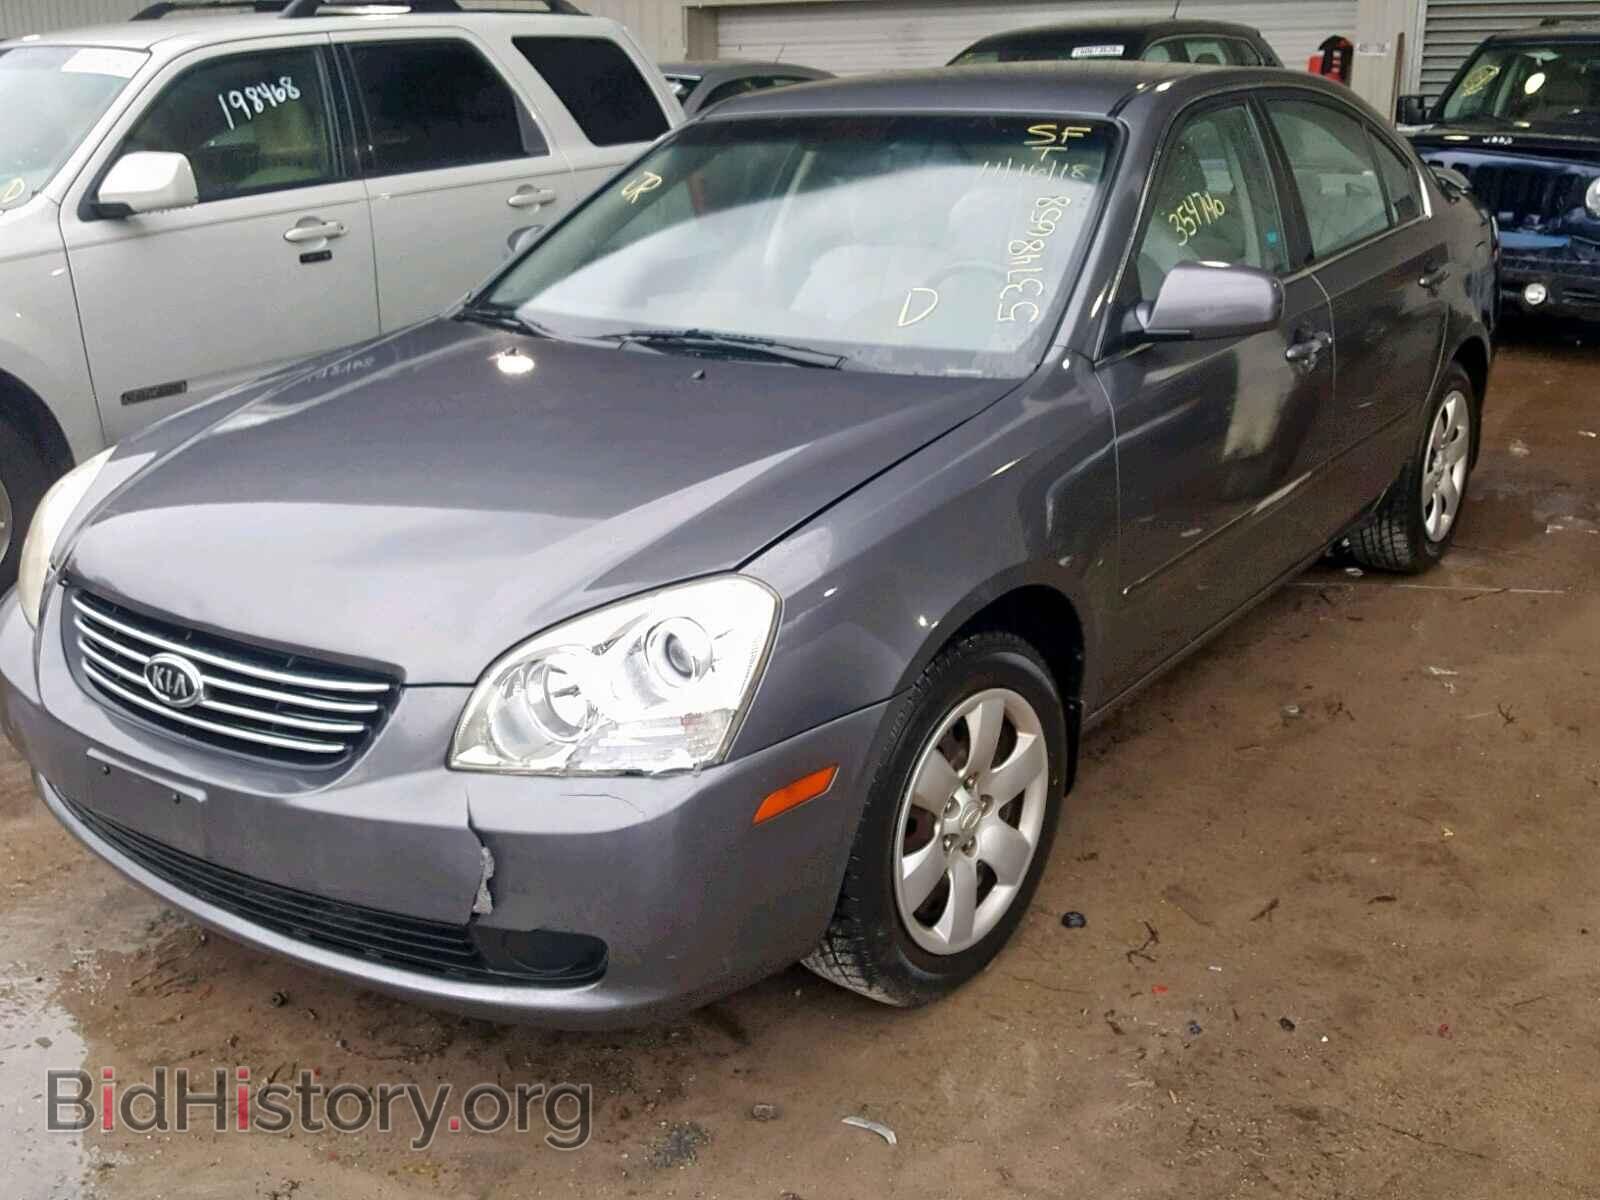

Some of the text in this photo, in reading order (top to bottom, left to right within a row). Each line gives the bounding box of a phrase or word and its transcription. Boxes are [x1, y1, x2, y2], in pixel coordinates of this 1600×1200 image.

[217, 75, 301, 131] 198468
[1023, 123, 1092, 146] SF
[898, 287, 939, 327] D
[152, 664, 188, 697] KIA
